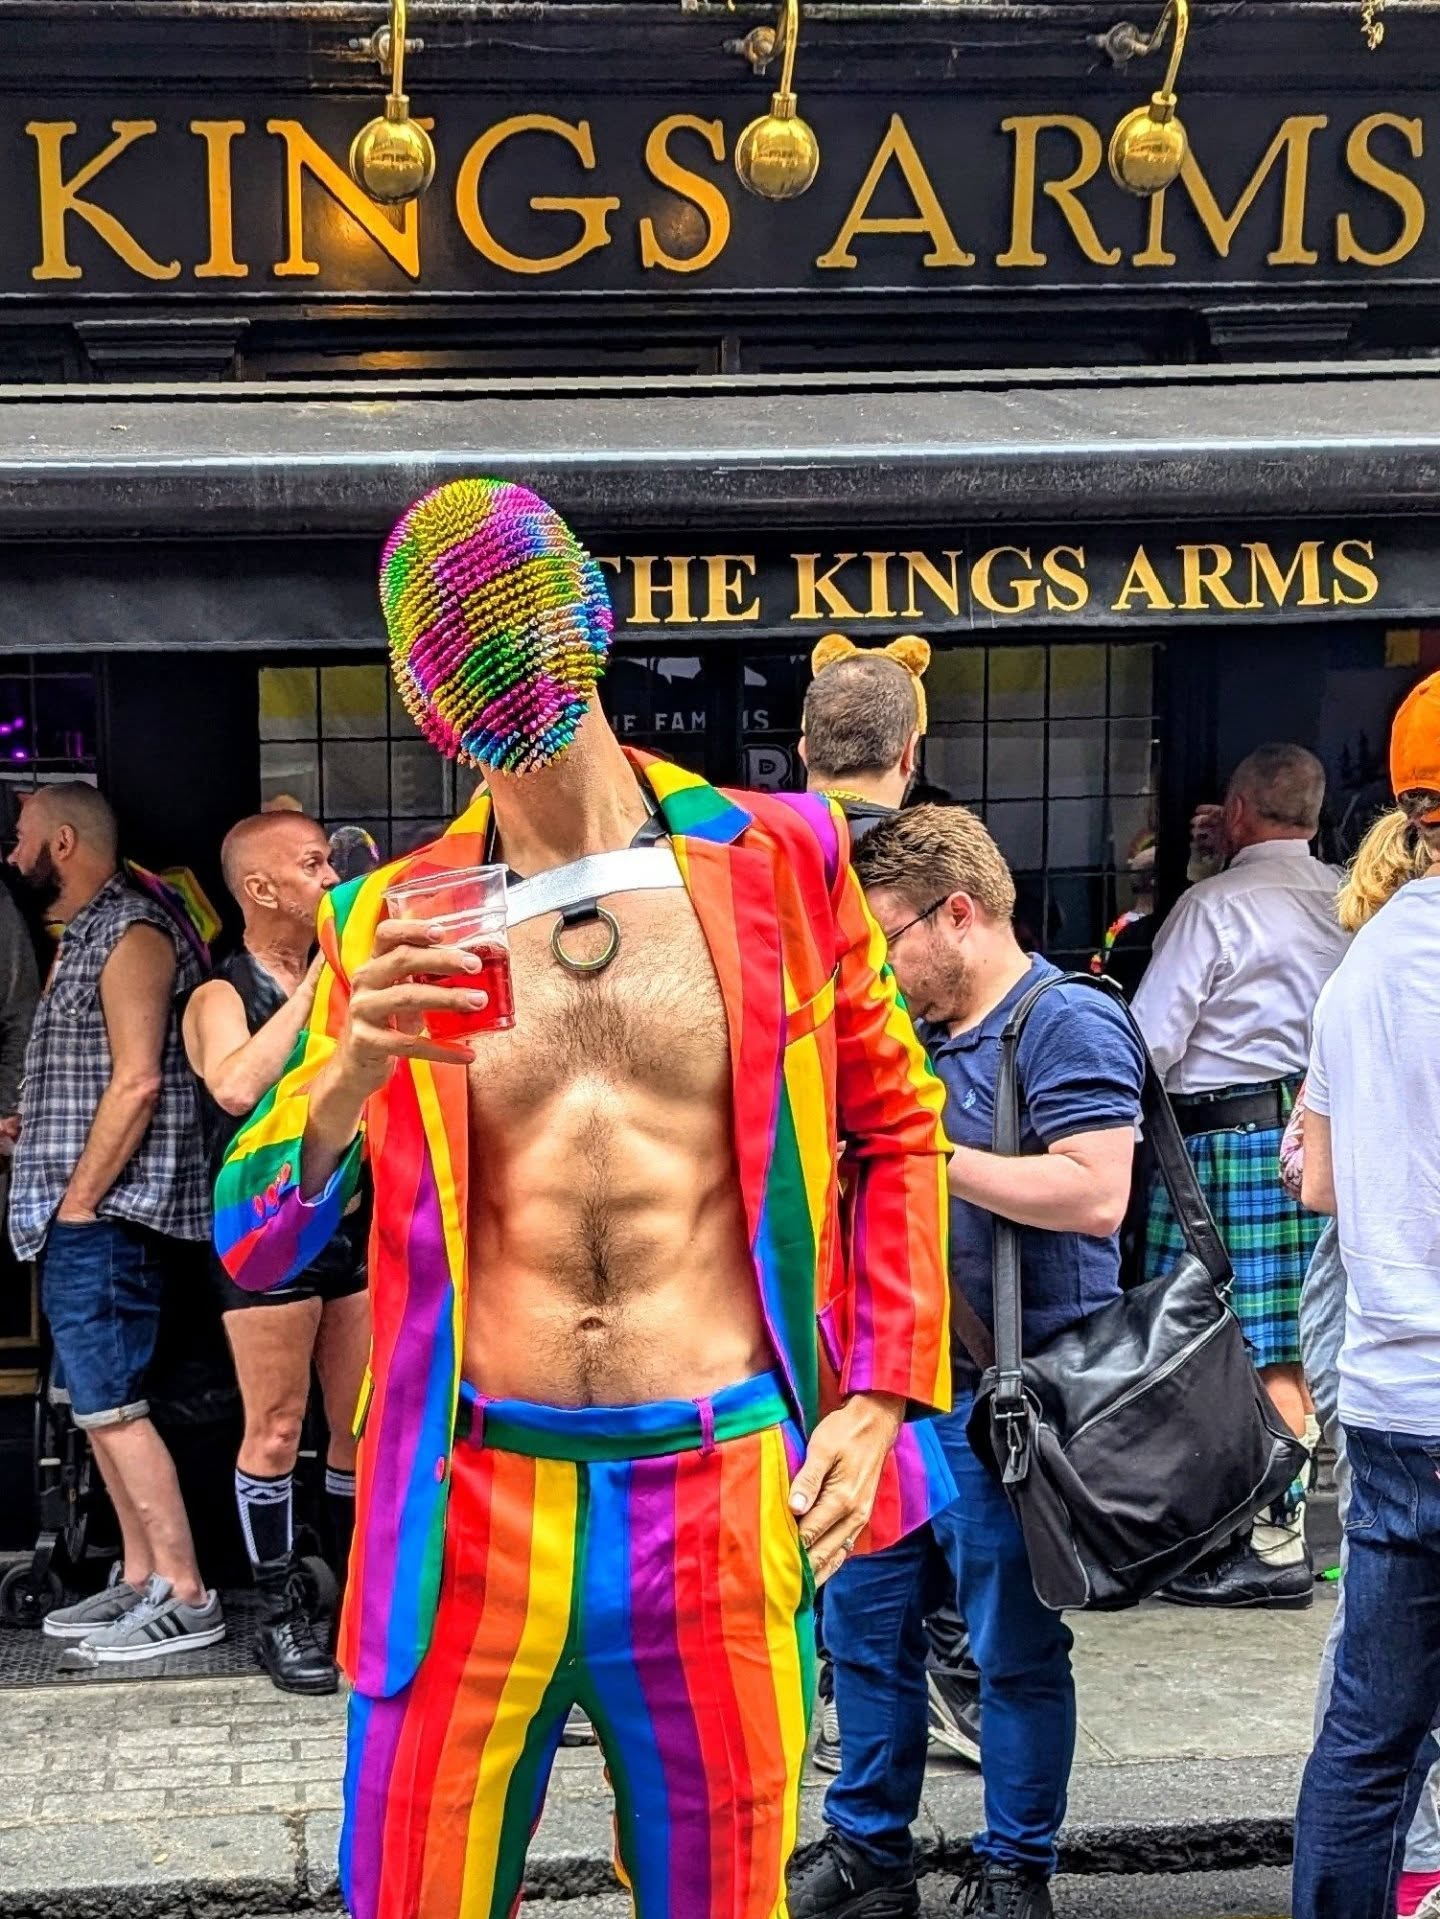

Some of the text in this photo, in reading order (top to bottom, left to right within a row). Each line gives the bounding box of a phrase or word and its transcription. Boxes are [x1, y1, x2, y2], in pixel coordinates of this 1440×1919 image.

[26, 112, 1425, 280] KINGS ARMS
[790, 545, 1090, 620] KINGS
[1111, 540, 1379, 610] ARMS
[655, 709, 769, 731] FAMS
